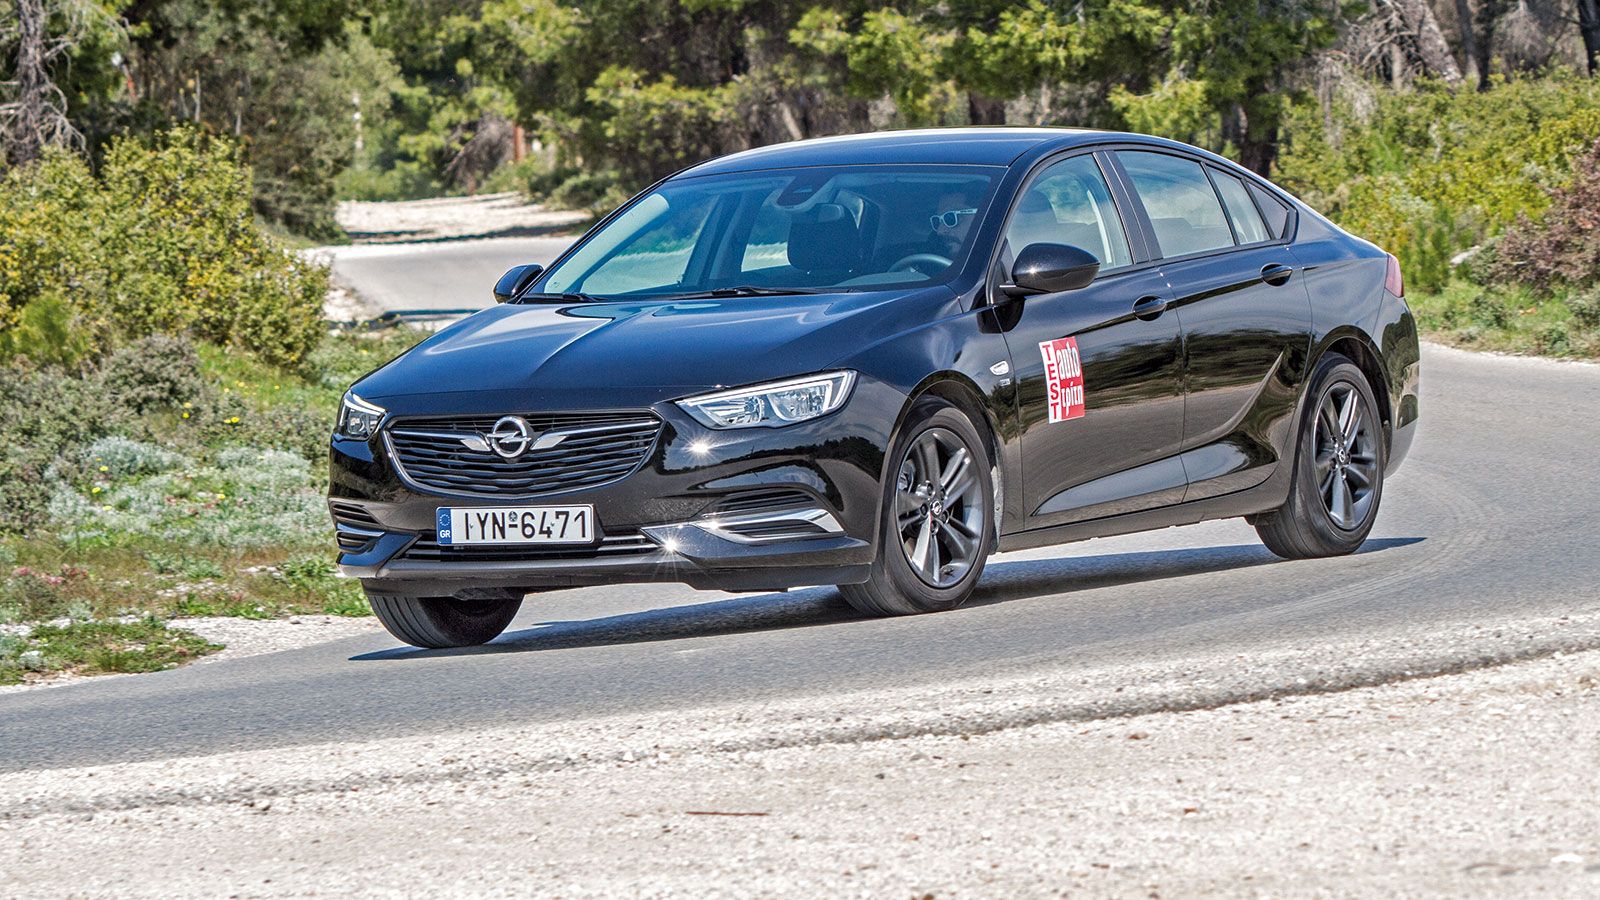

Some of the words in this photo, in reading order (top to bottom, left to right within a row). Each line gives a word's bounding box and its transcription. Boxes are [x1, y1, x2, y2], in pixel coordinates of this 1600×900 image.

[1056, 341, 1081, 380] auto
[1042, 344, 1059, 420] TEST
[439, 529, 451, 538] GR
